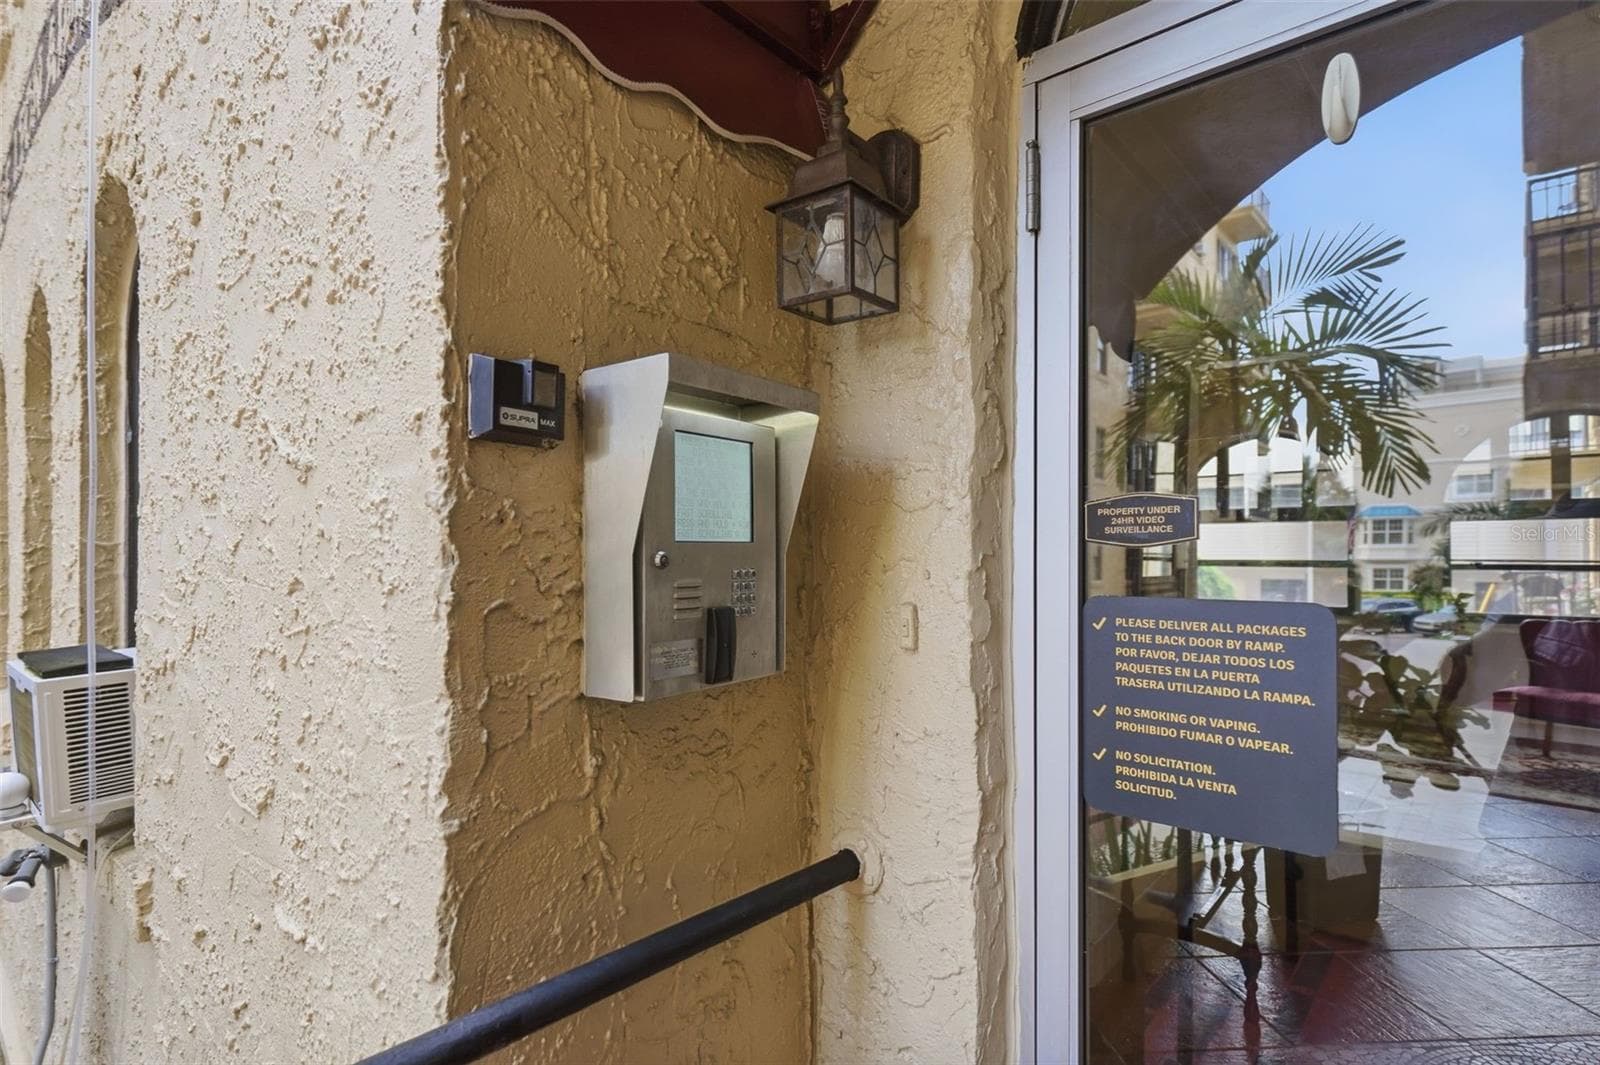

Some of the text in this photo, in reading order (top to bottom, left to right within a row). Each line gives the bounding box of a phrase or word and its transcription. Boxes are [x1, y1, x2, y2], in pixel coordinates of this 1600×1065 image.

[510, 414, 536, 423] SUPRA
[1098, 505, 1180, 516] PROPERTY UNDER
[1105, 525, 1173, 534] SURVEILLANCE
[1115, 618, 1307, 637] PLEASE DELIVER ALL PACKAGES
[1115, 632, 1286, 653] TO THE BACK DOOR BY RAMP.
[1115, 648, 1295, 671] POR FAVOR, DEJAR TODOS LOS
[1115, 662, 1260, 684] PAQUETES EN LA PUERTA
[1115, 677, 1316, 706] TRASERA UTILIZANDO LA RAMPA.
[1116, 706, 1261, 734] NO SMOKING OR VAPING.
[1116, 721, 1294, 755] PROHIBIDO FUMAR O VAPEAR.
[1116, 751, 1216, 776] NO SOLICITATION.
[1115, 780, 1177, 800] SOLICITUD.
[1116, 765, 1237, 795] PROHIBIDA LA VENTA
